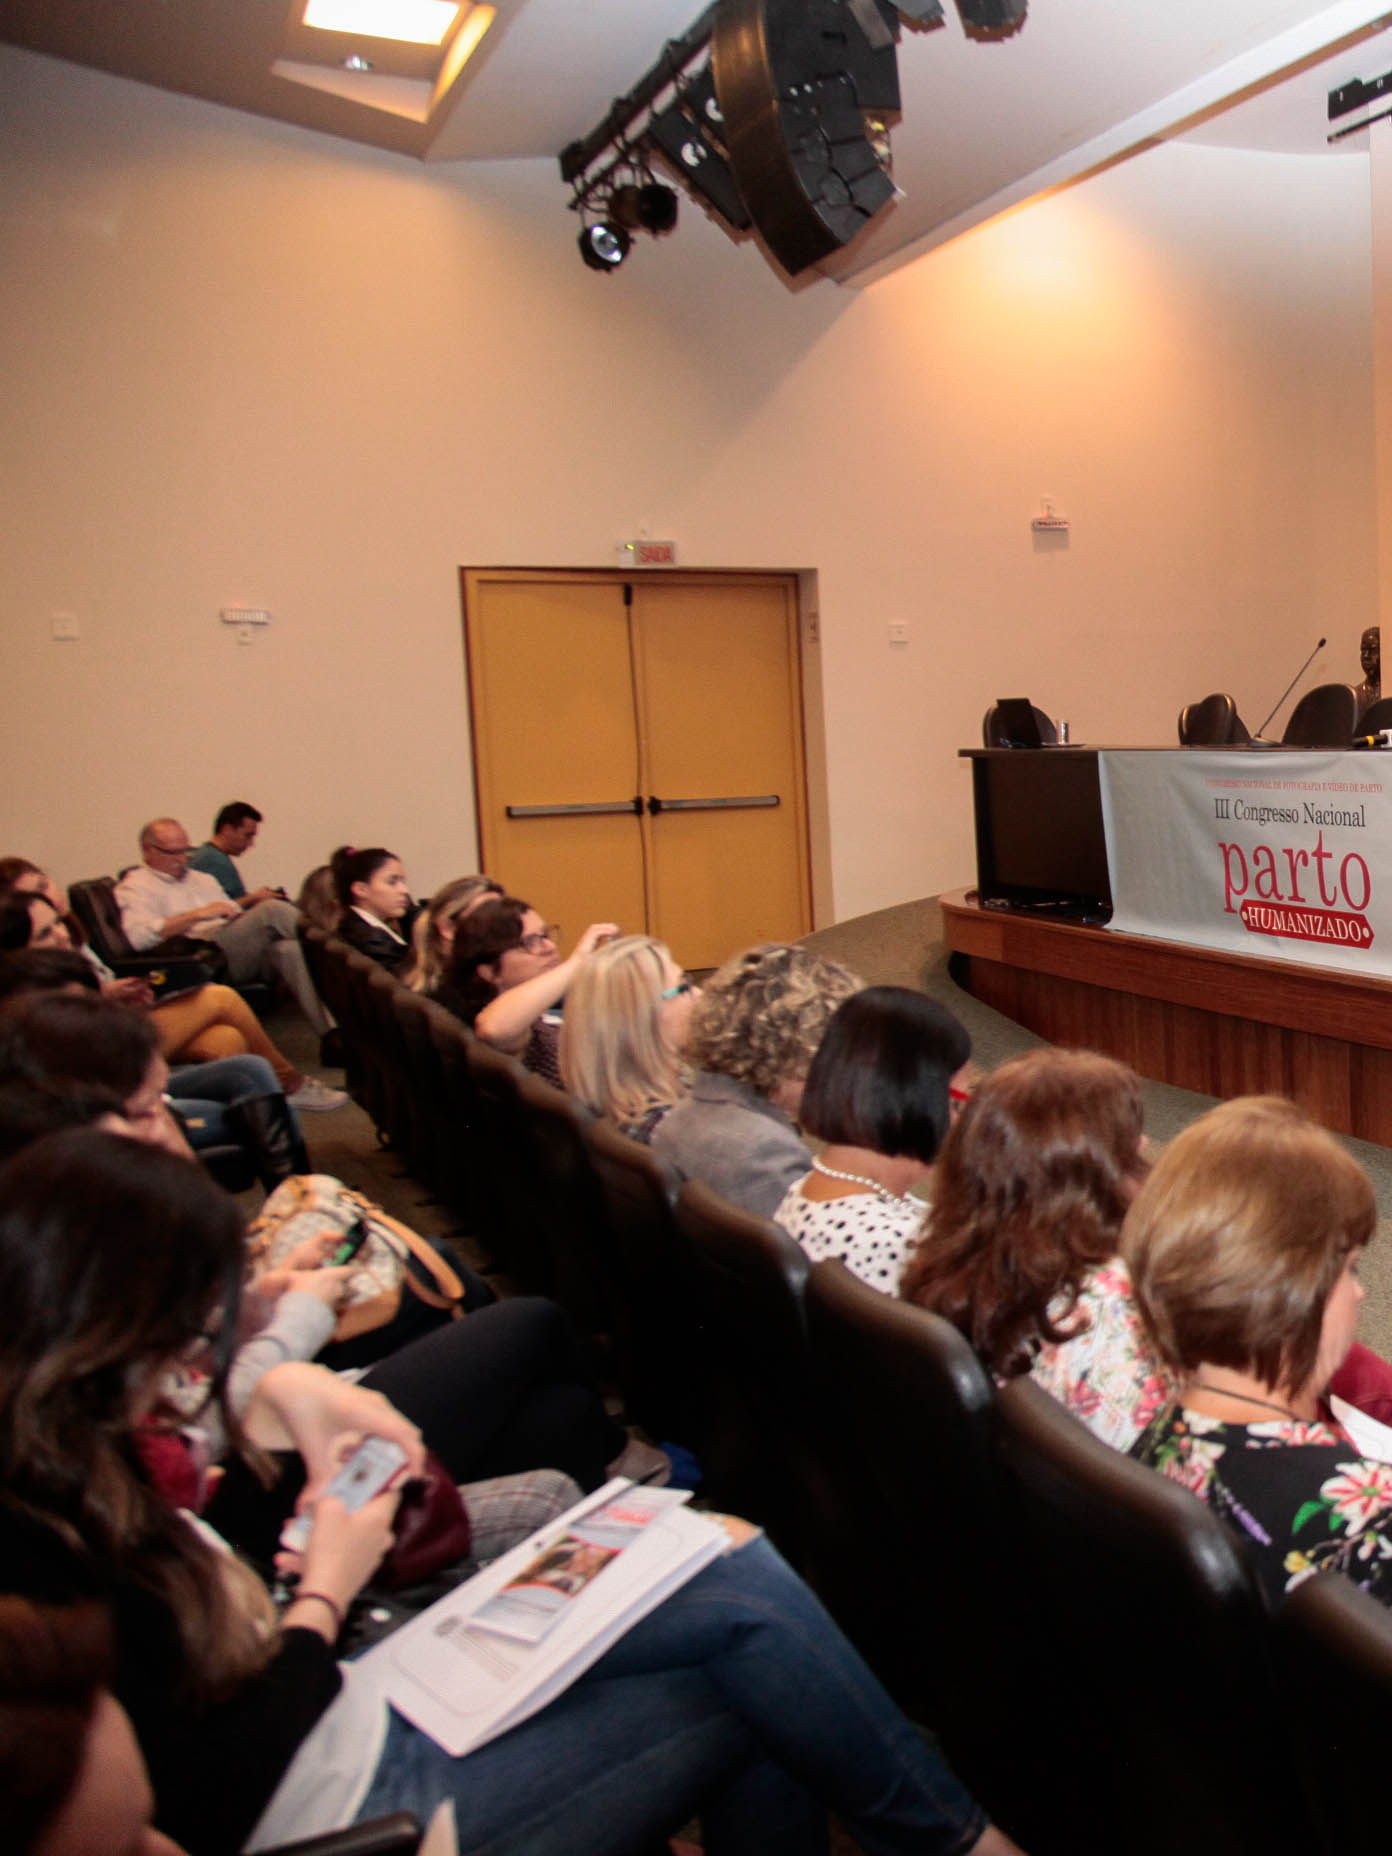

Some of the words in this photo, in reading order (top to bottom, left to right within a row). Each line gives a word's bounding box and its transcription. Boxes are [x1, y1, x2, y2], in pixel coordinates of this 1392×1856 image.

[1360, 784, 1383, 793] PARTO
[1213, 798, 1230, 819] III
[1233, 799, 1299, 826] Congresso
[1303, 802, 1366, 828] Nacional
[1218, 830, 1372, 914] parto
[1246, 906, 1362, 943] HUMANIZADO
